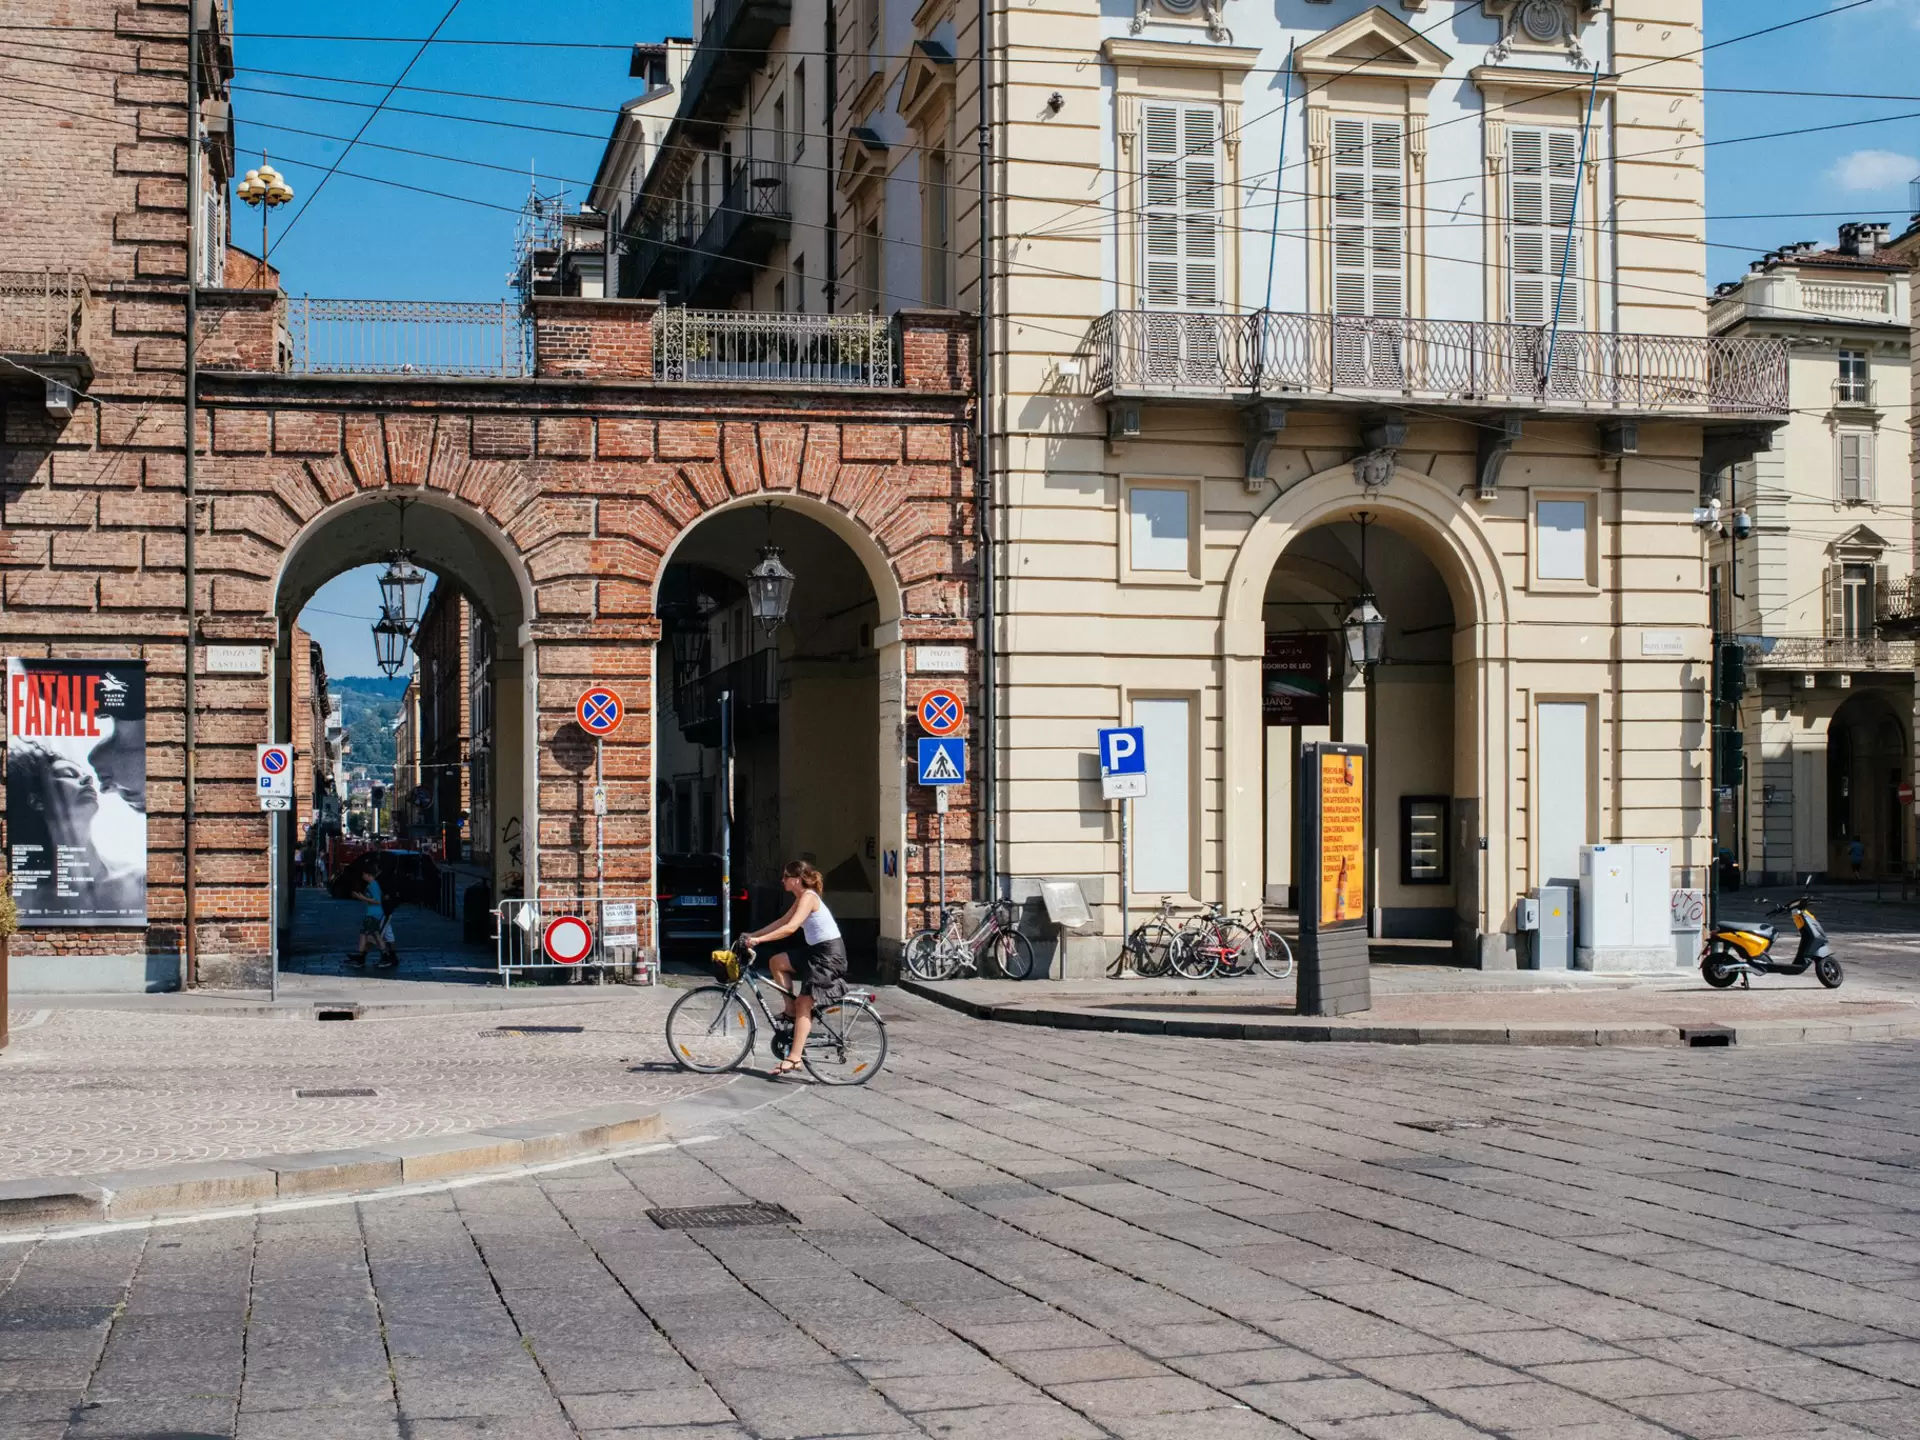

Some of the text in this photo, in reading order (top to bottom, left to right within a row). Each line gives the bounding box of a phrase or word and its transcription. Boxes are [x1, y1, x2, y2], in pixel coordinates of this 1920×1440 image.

[12, 675, 100, 736] FATALE
[1108, 733, 1136, 770] P
[262, 778, 270, 786] P
